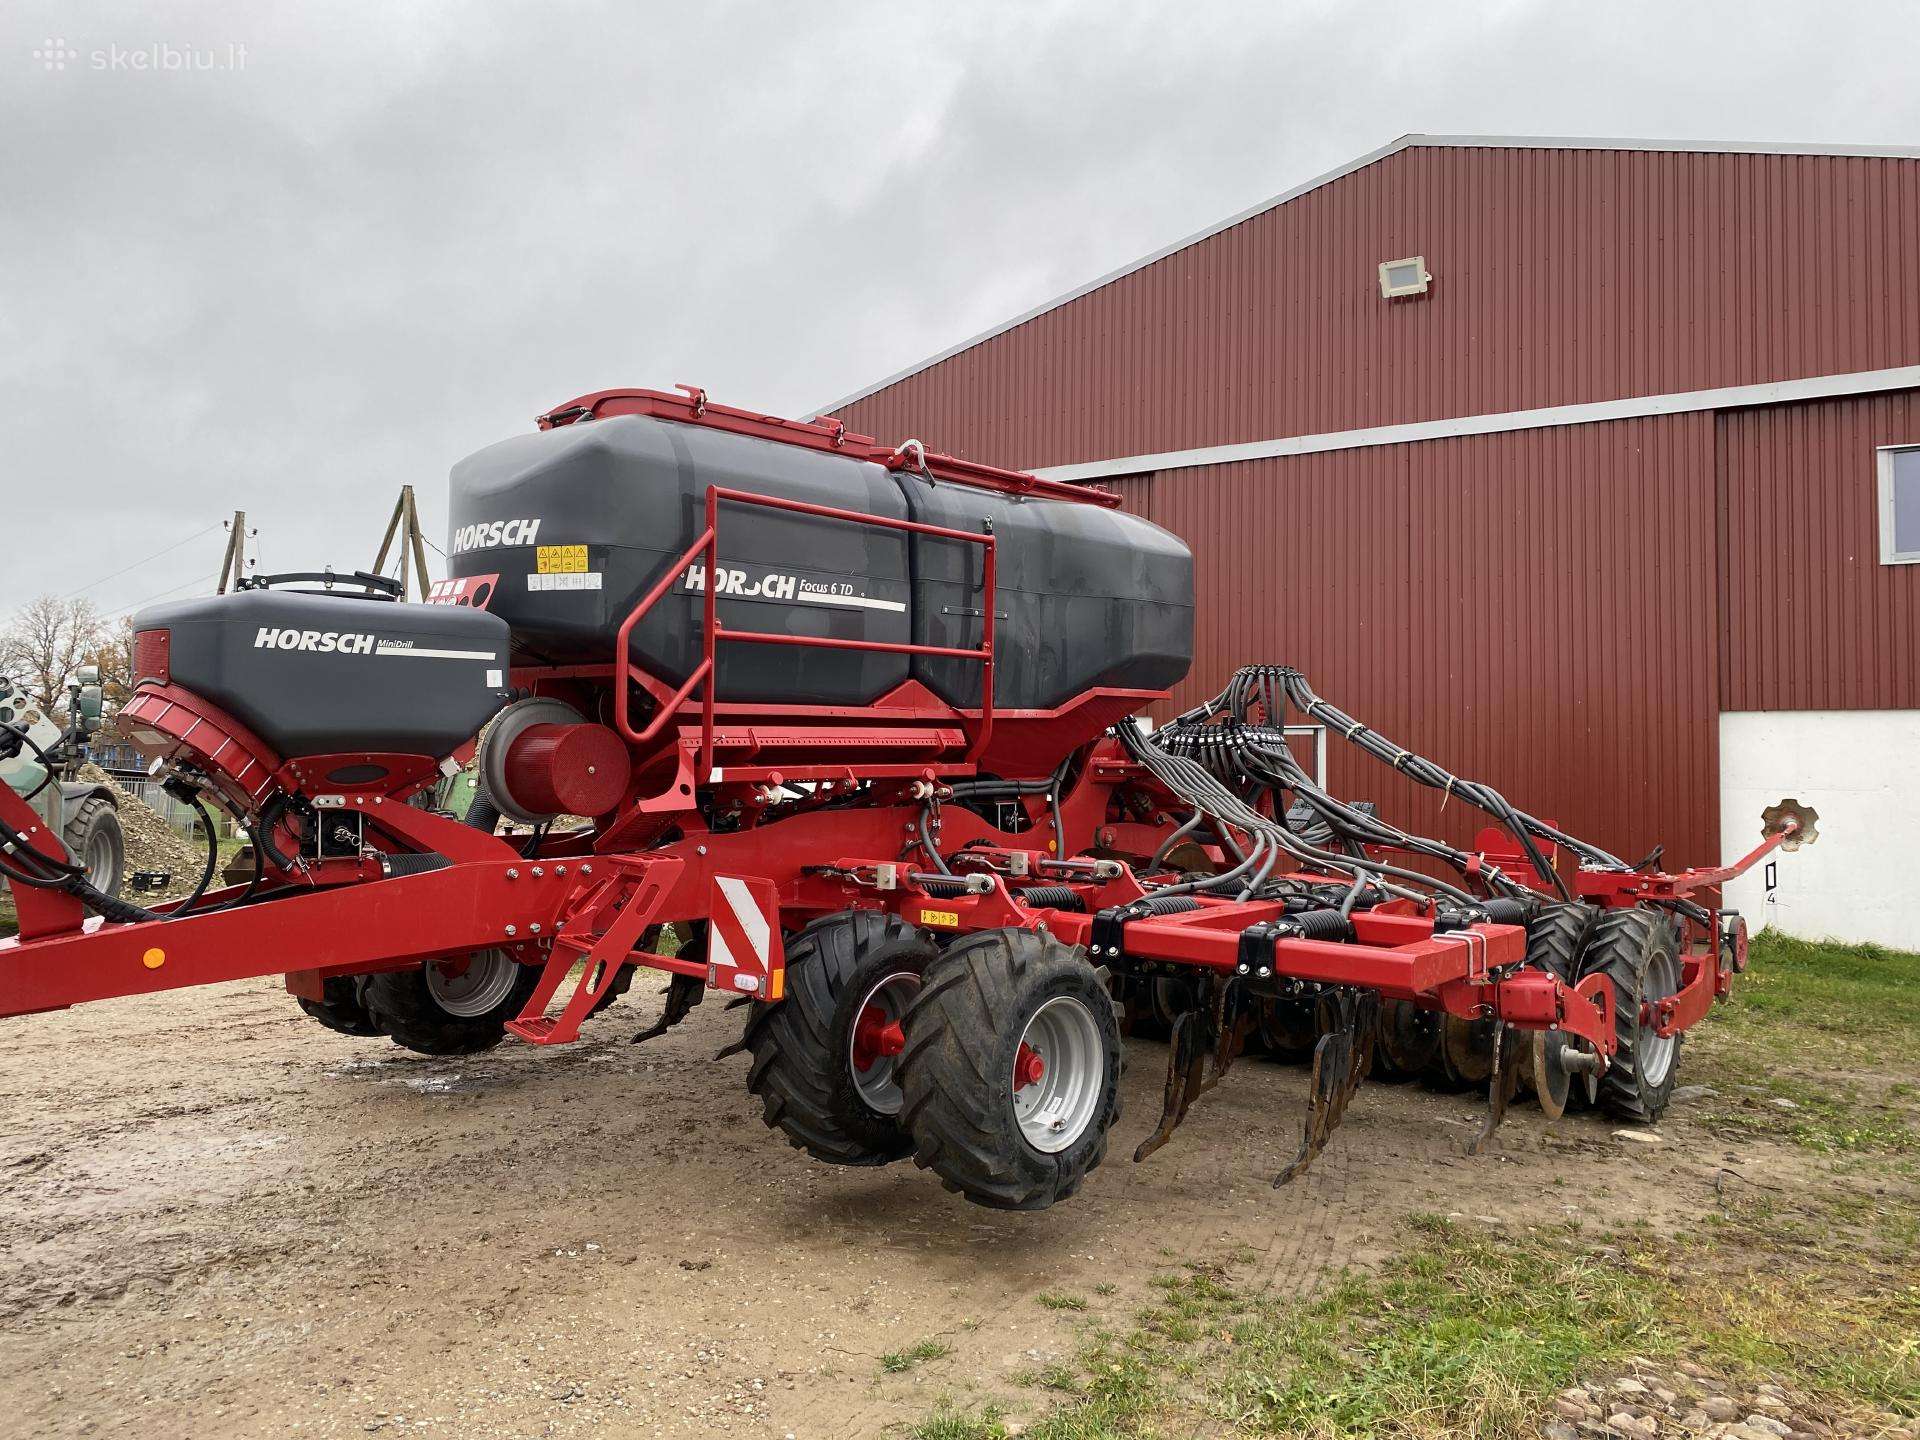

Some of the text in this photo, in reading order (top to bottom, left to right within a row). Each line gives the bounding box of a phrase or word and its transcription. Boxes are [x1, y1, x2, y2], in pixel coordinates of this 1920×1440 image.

[453, 518, 541, 553] HORSCH
[800, 579, 829, 593] Focus
[831, 582, 838, 595] 6
[840, 583, 853, 596] TD
[254, 627, 414, 655] HORSCH MiniDrill
[1767, 892, 1776, 904] 4
